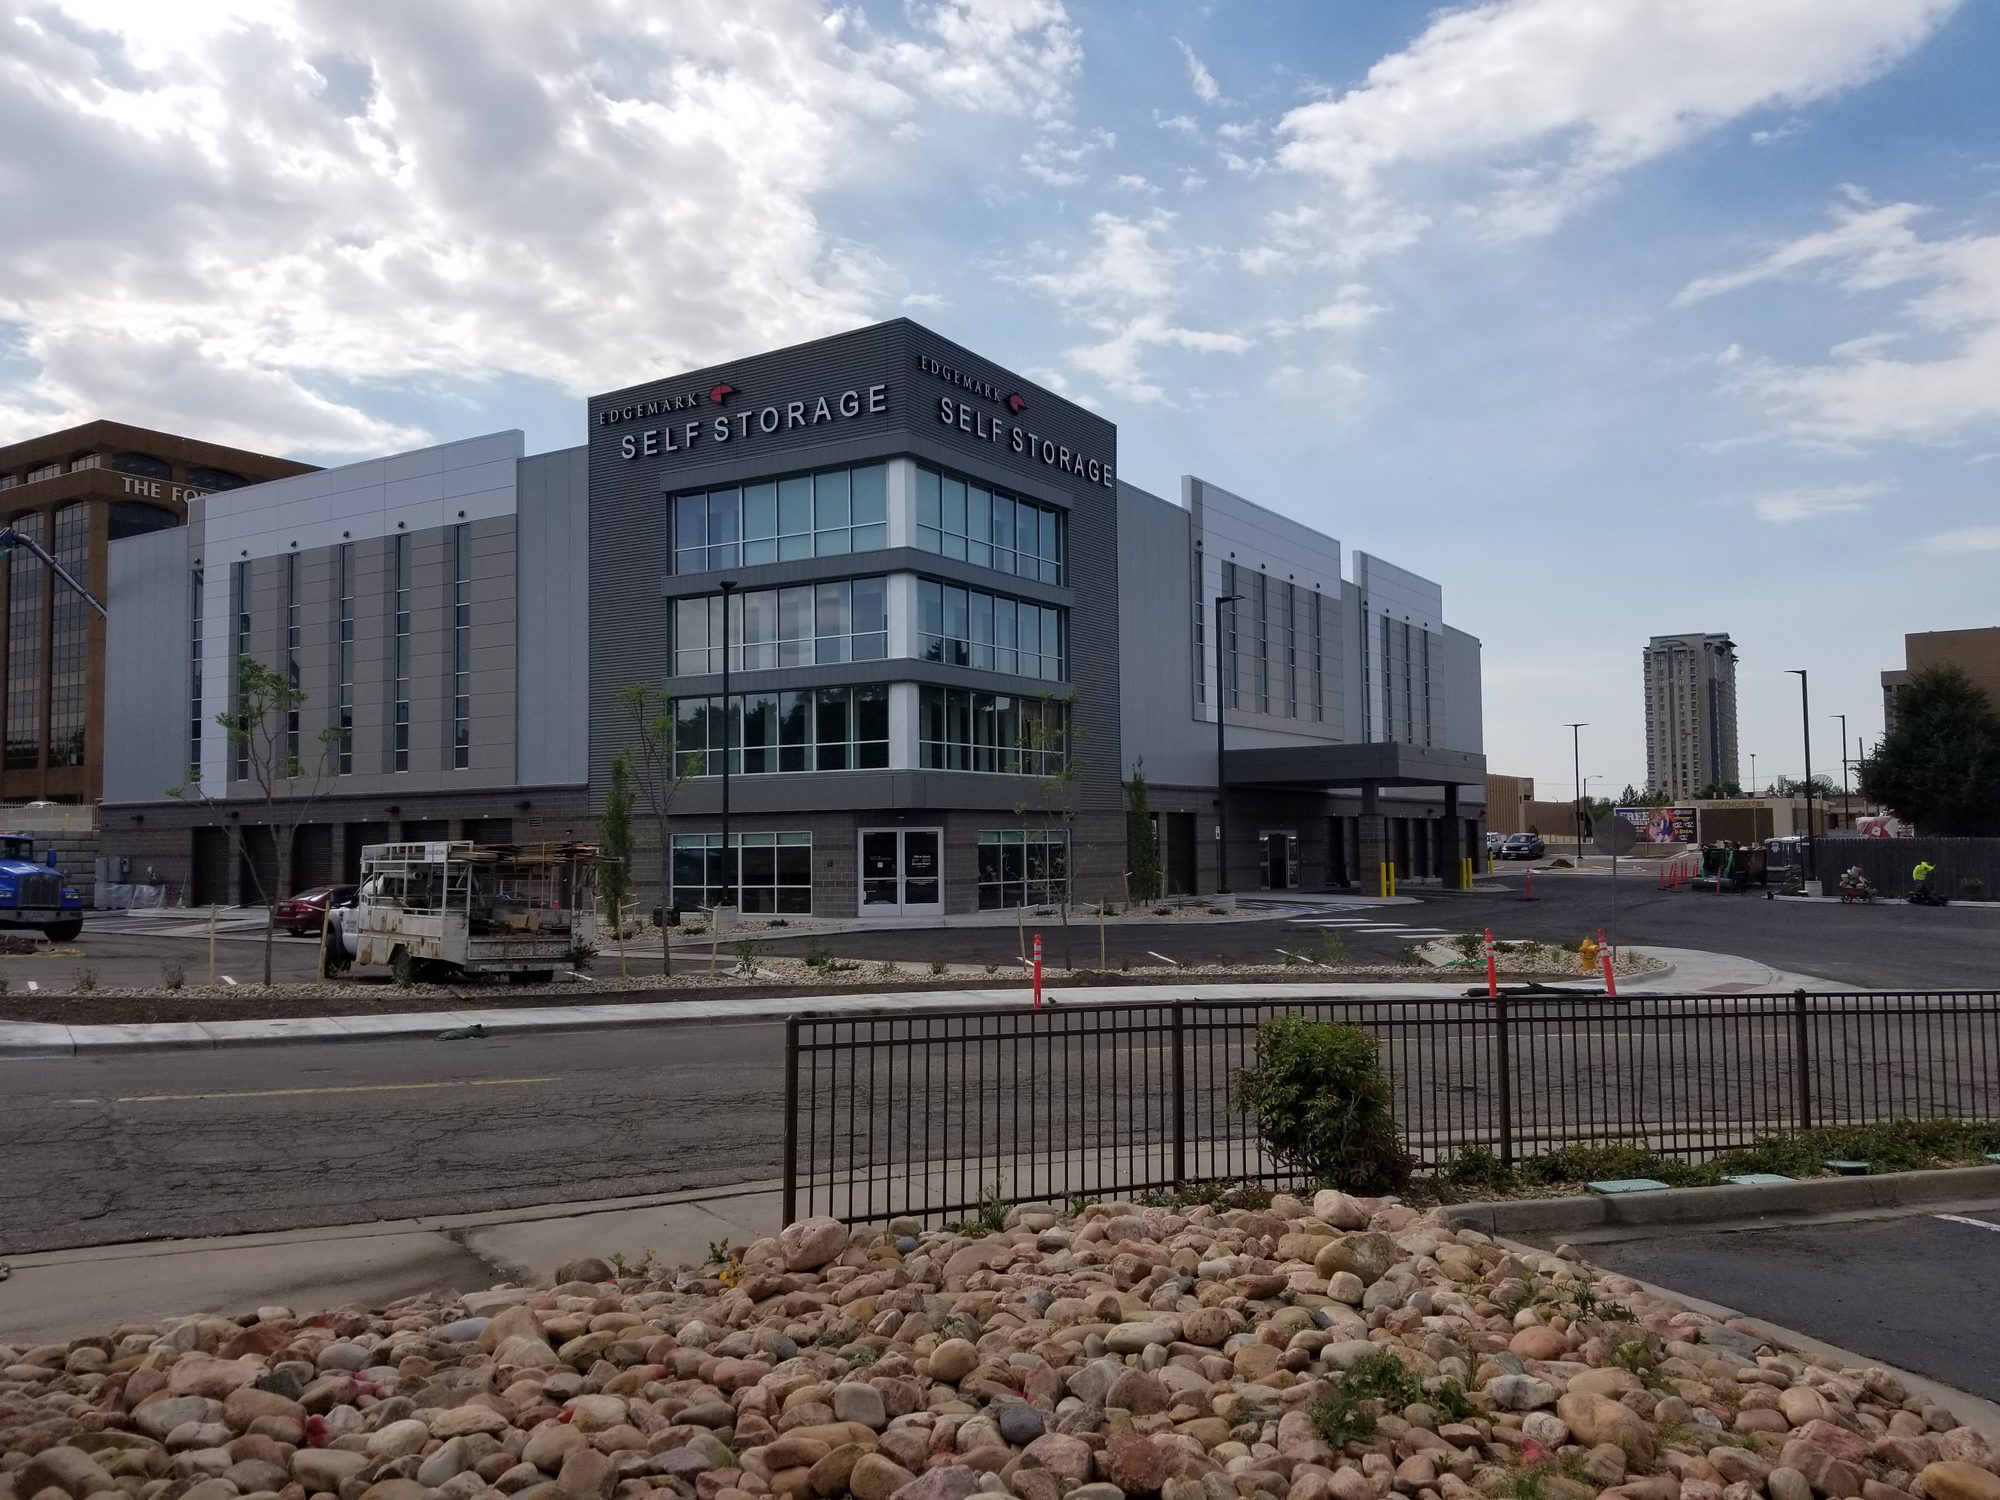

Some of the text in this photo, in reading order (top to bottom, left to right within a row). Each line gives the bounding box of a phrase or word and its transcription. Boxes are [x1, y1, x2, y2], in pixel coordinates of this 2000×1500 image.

[921, 355, 1001, 402] EDGEMARK
[599, 393, 698, 425] EDGEMARK
[621, 384, 887, 460] SELF STORAGE
[941, 396, 1113, 488] SELF STORAGE
[121, 476, 161, 498] THE
